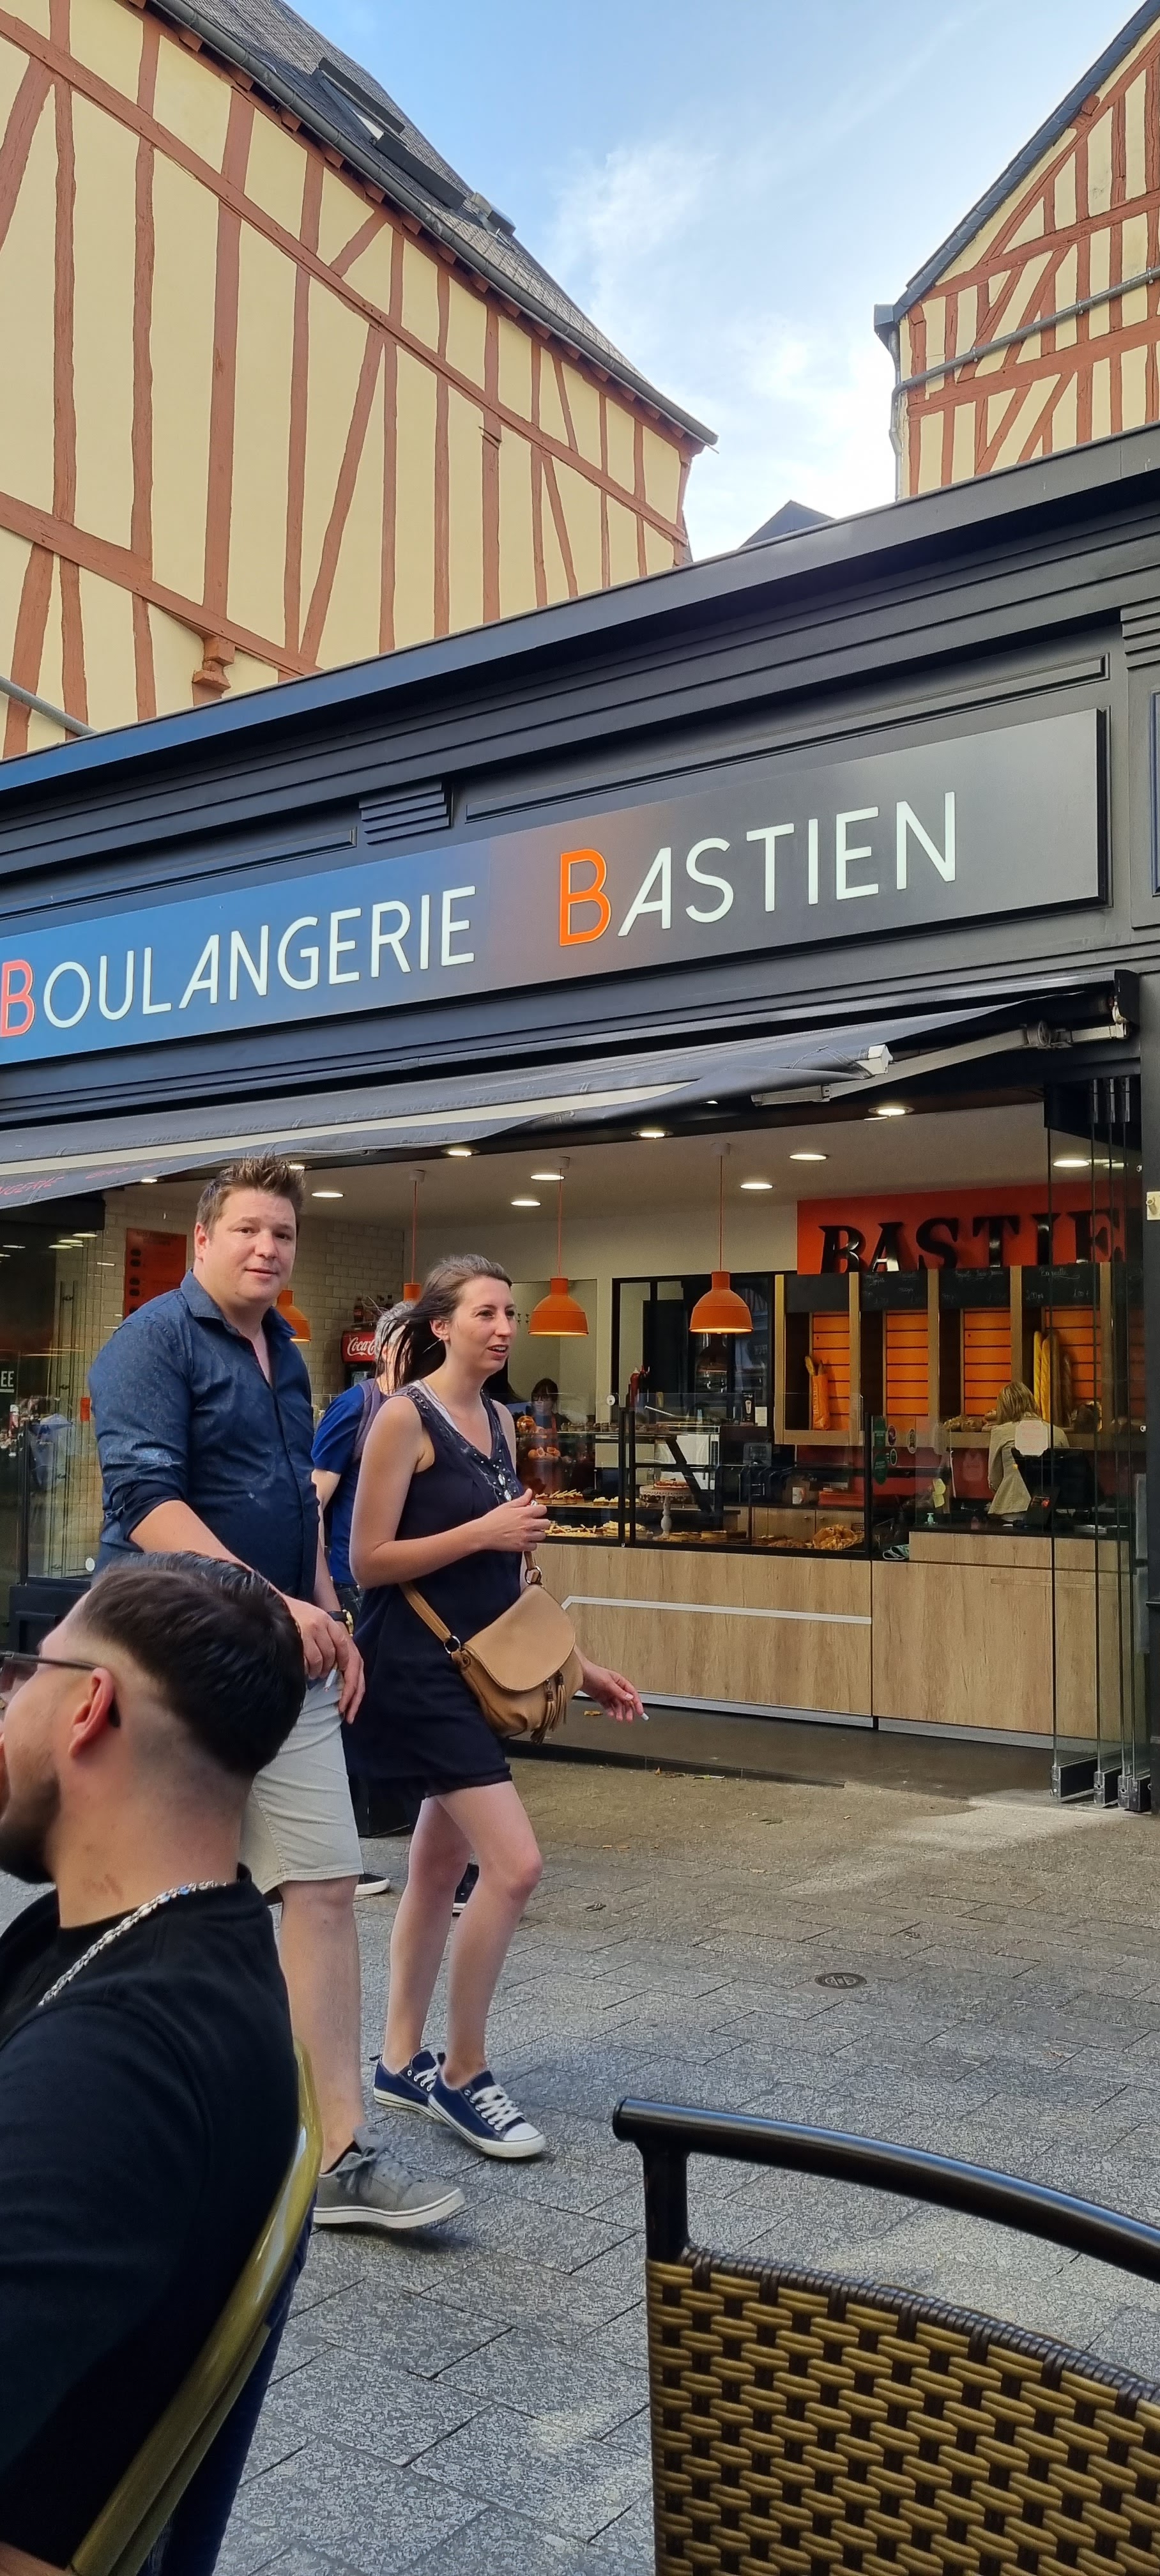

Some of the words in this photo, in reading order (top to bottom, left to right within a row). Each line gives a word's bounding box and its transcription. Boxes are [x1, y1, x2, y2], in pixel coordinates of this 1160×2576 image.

[0, 885, 477, 1037] BOULANGERIE
[558, 791, 956, 947] BASTIEN
[818, 1208, 1122, 1274] BASTIE
[347, 1337, 376, 1356] Coca-C
